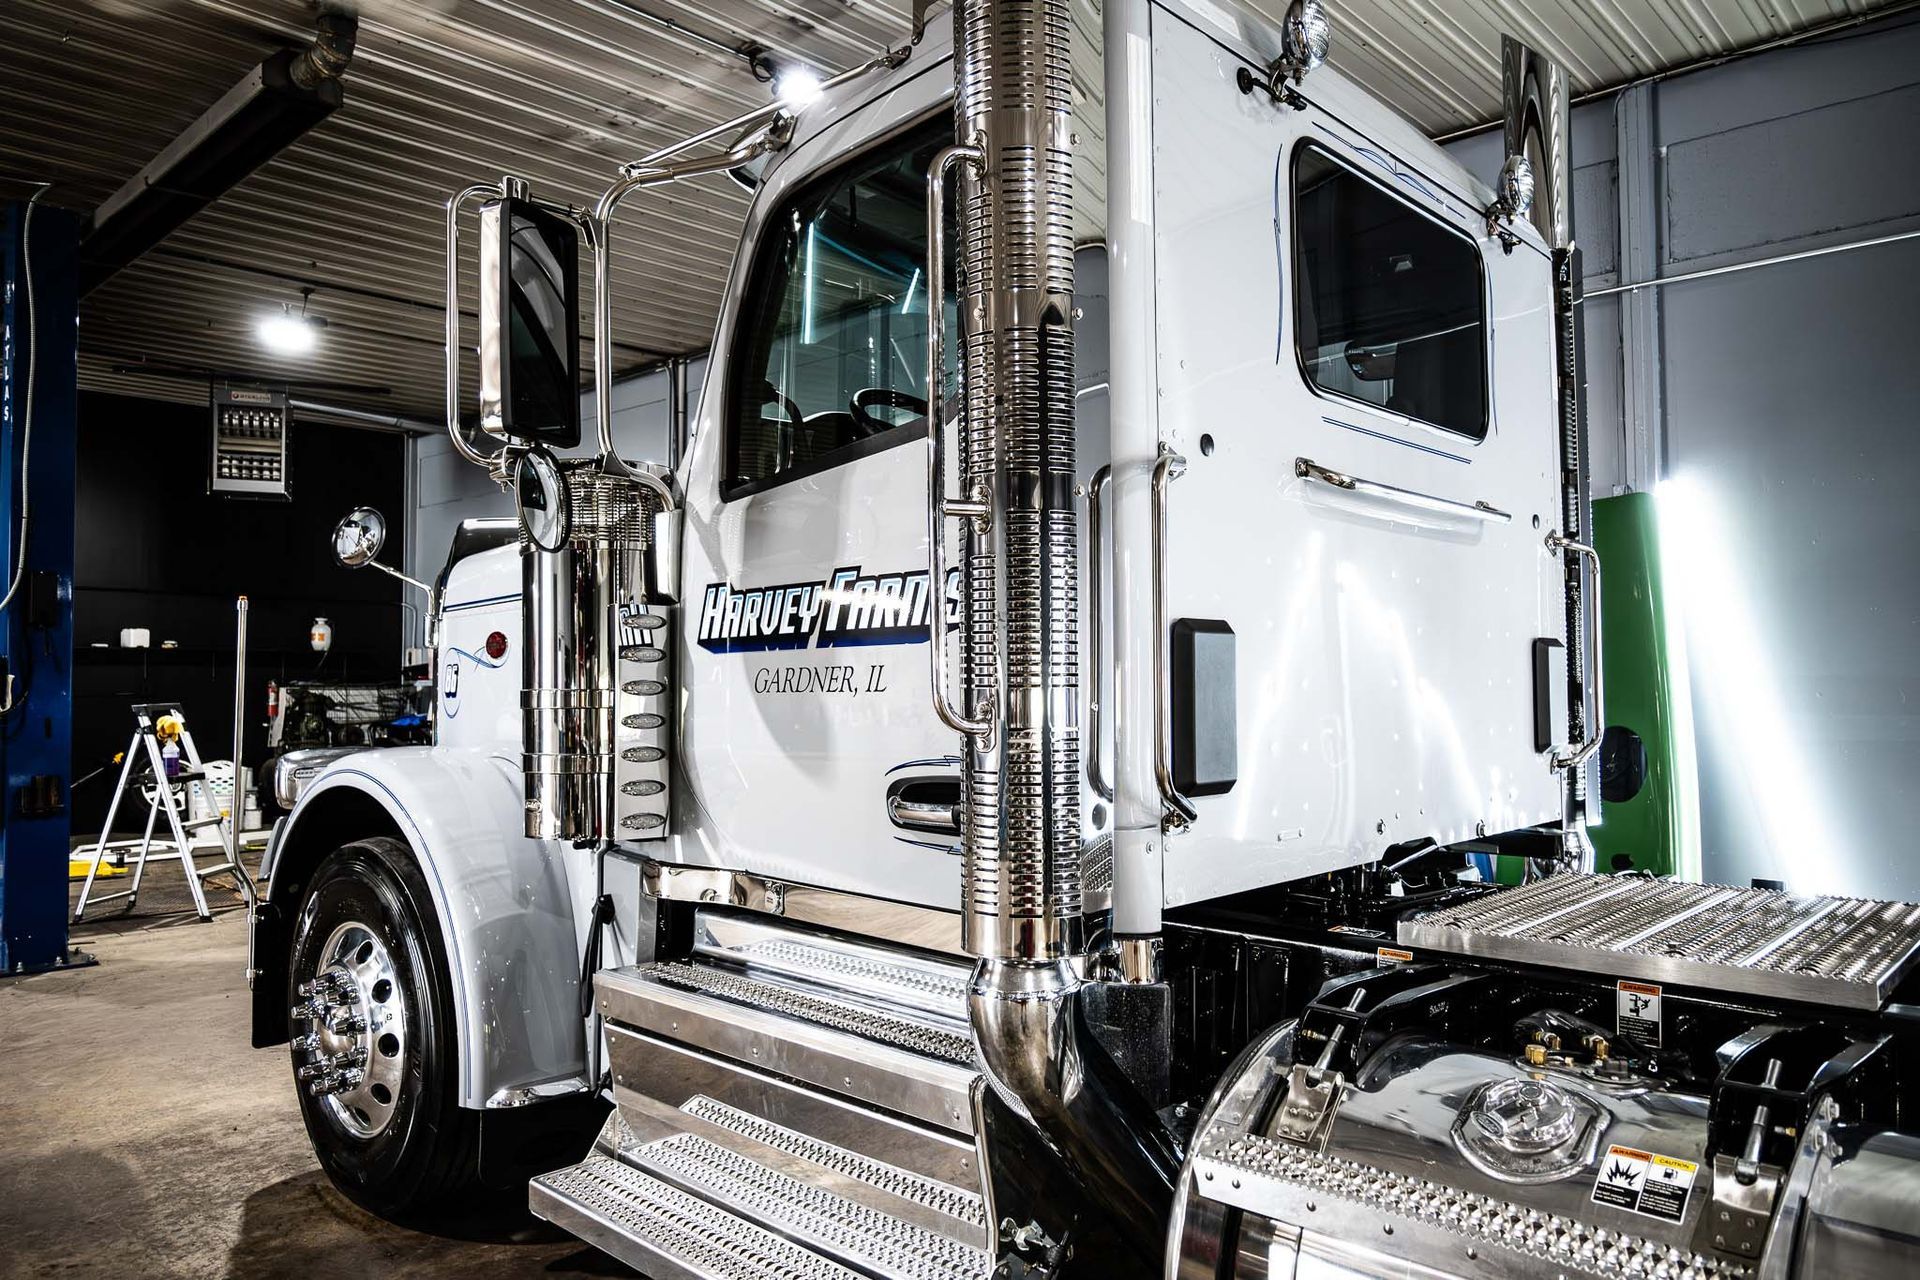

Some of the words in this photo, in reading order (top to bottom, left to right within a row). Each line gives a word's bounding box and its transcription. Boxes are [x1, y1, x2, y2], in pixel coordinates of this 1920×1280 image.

[3, 324, 11, 421] ATLAS
[699, 581, 826, 649] HARVEY
[754, 666, 858, 697] GARDNER,
[866, 664, 887, 693] IL
[1660, 1158, 1689, 1169] CAUTION
